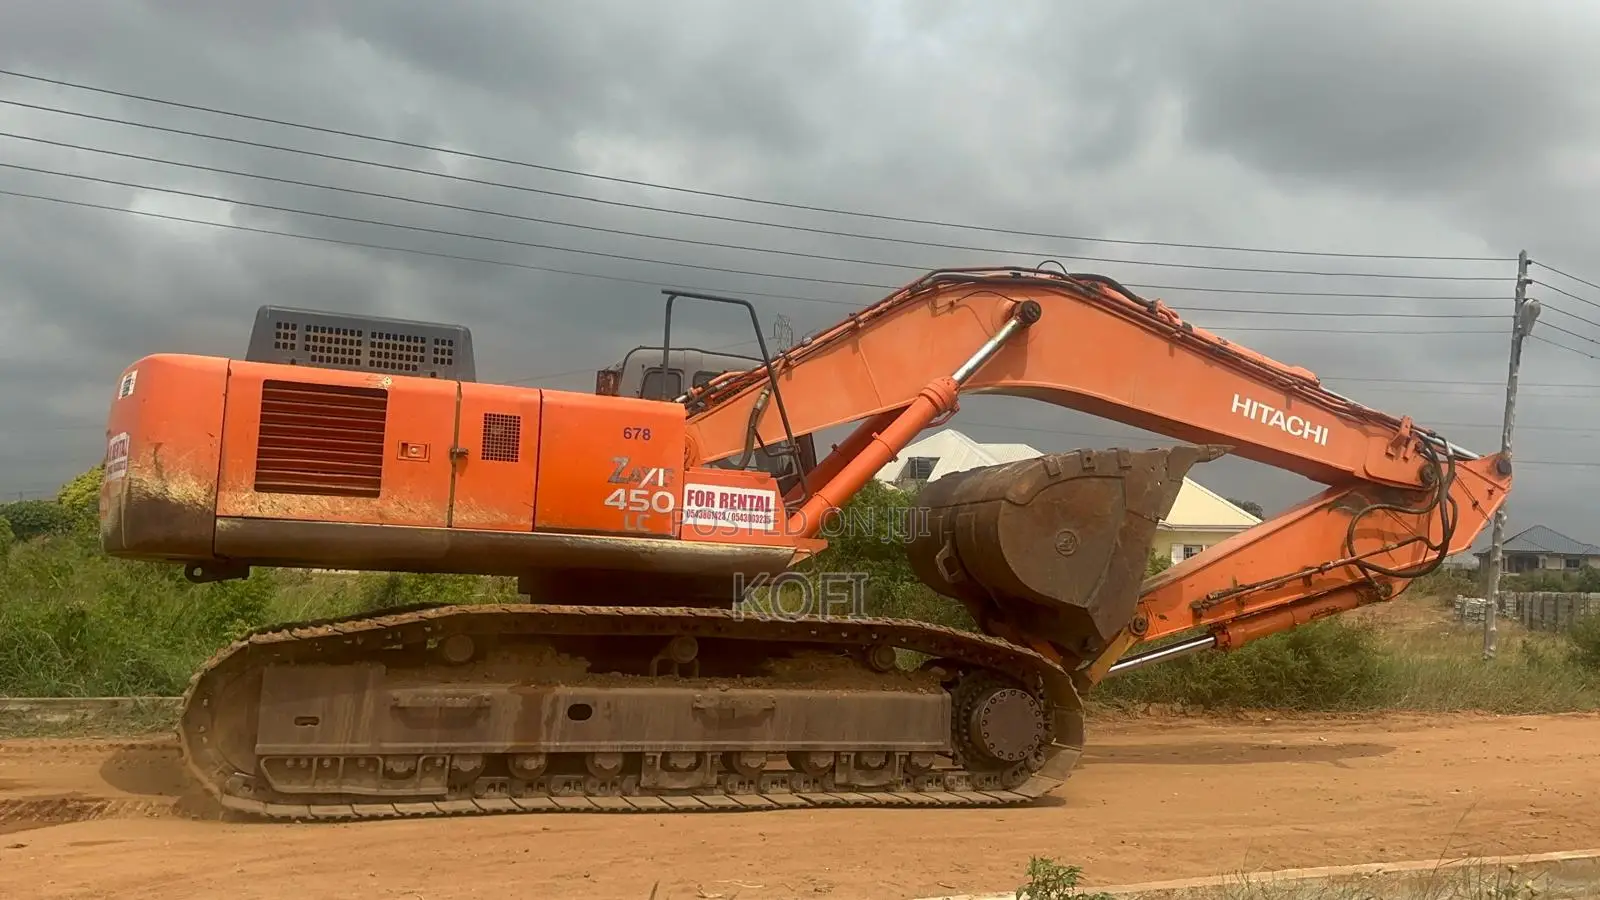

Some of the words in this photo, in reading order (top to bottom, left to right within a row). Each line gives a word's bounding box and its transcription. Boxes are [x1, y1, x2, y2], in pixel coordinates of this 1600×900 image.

[1231, 393, 1329, 446] HITACHI
[623, 427, 651, 441] 678
[604, 488, 675, 513] 450
[686, 489, 715, 508] FOR
[719, 492, 772, 512] RENTAL
[623, 514, 651, 532] LC
